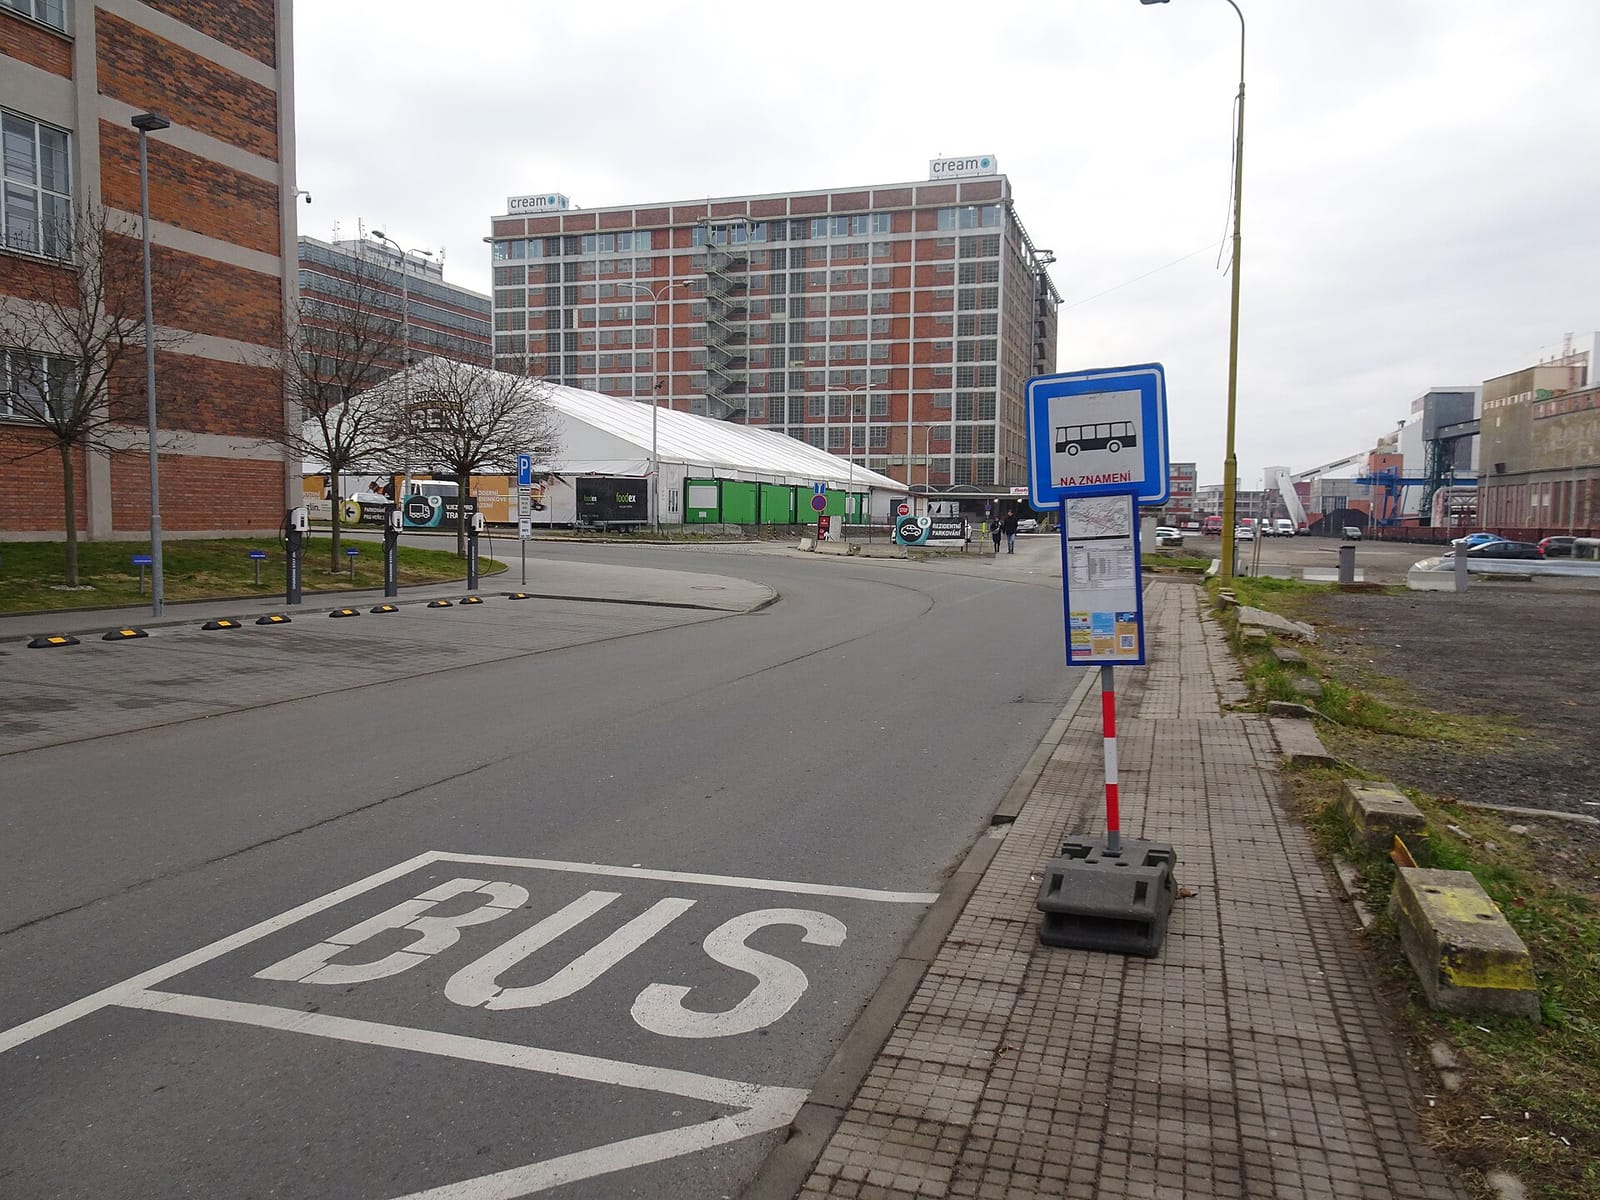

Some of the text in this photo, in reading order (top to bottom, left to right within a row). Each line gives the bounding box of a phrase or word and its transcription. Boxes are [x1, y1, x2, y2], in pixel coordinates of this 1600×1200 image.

[933, 159, 978, 173] cream
[511, 196, 546, 209] cream
[520, 457, 529, 476] P
[1060, 470, 1131, 486] NA ZNAMENÍ
[616, 491, 636, 503] foodex
[932, 529, 961, 537] PARKOVÁNÍ
[252, 877, 848, 1039] BUS
